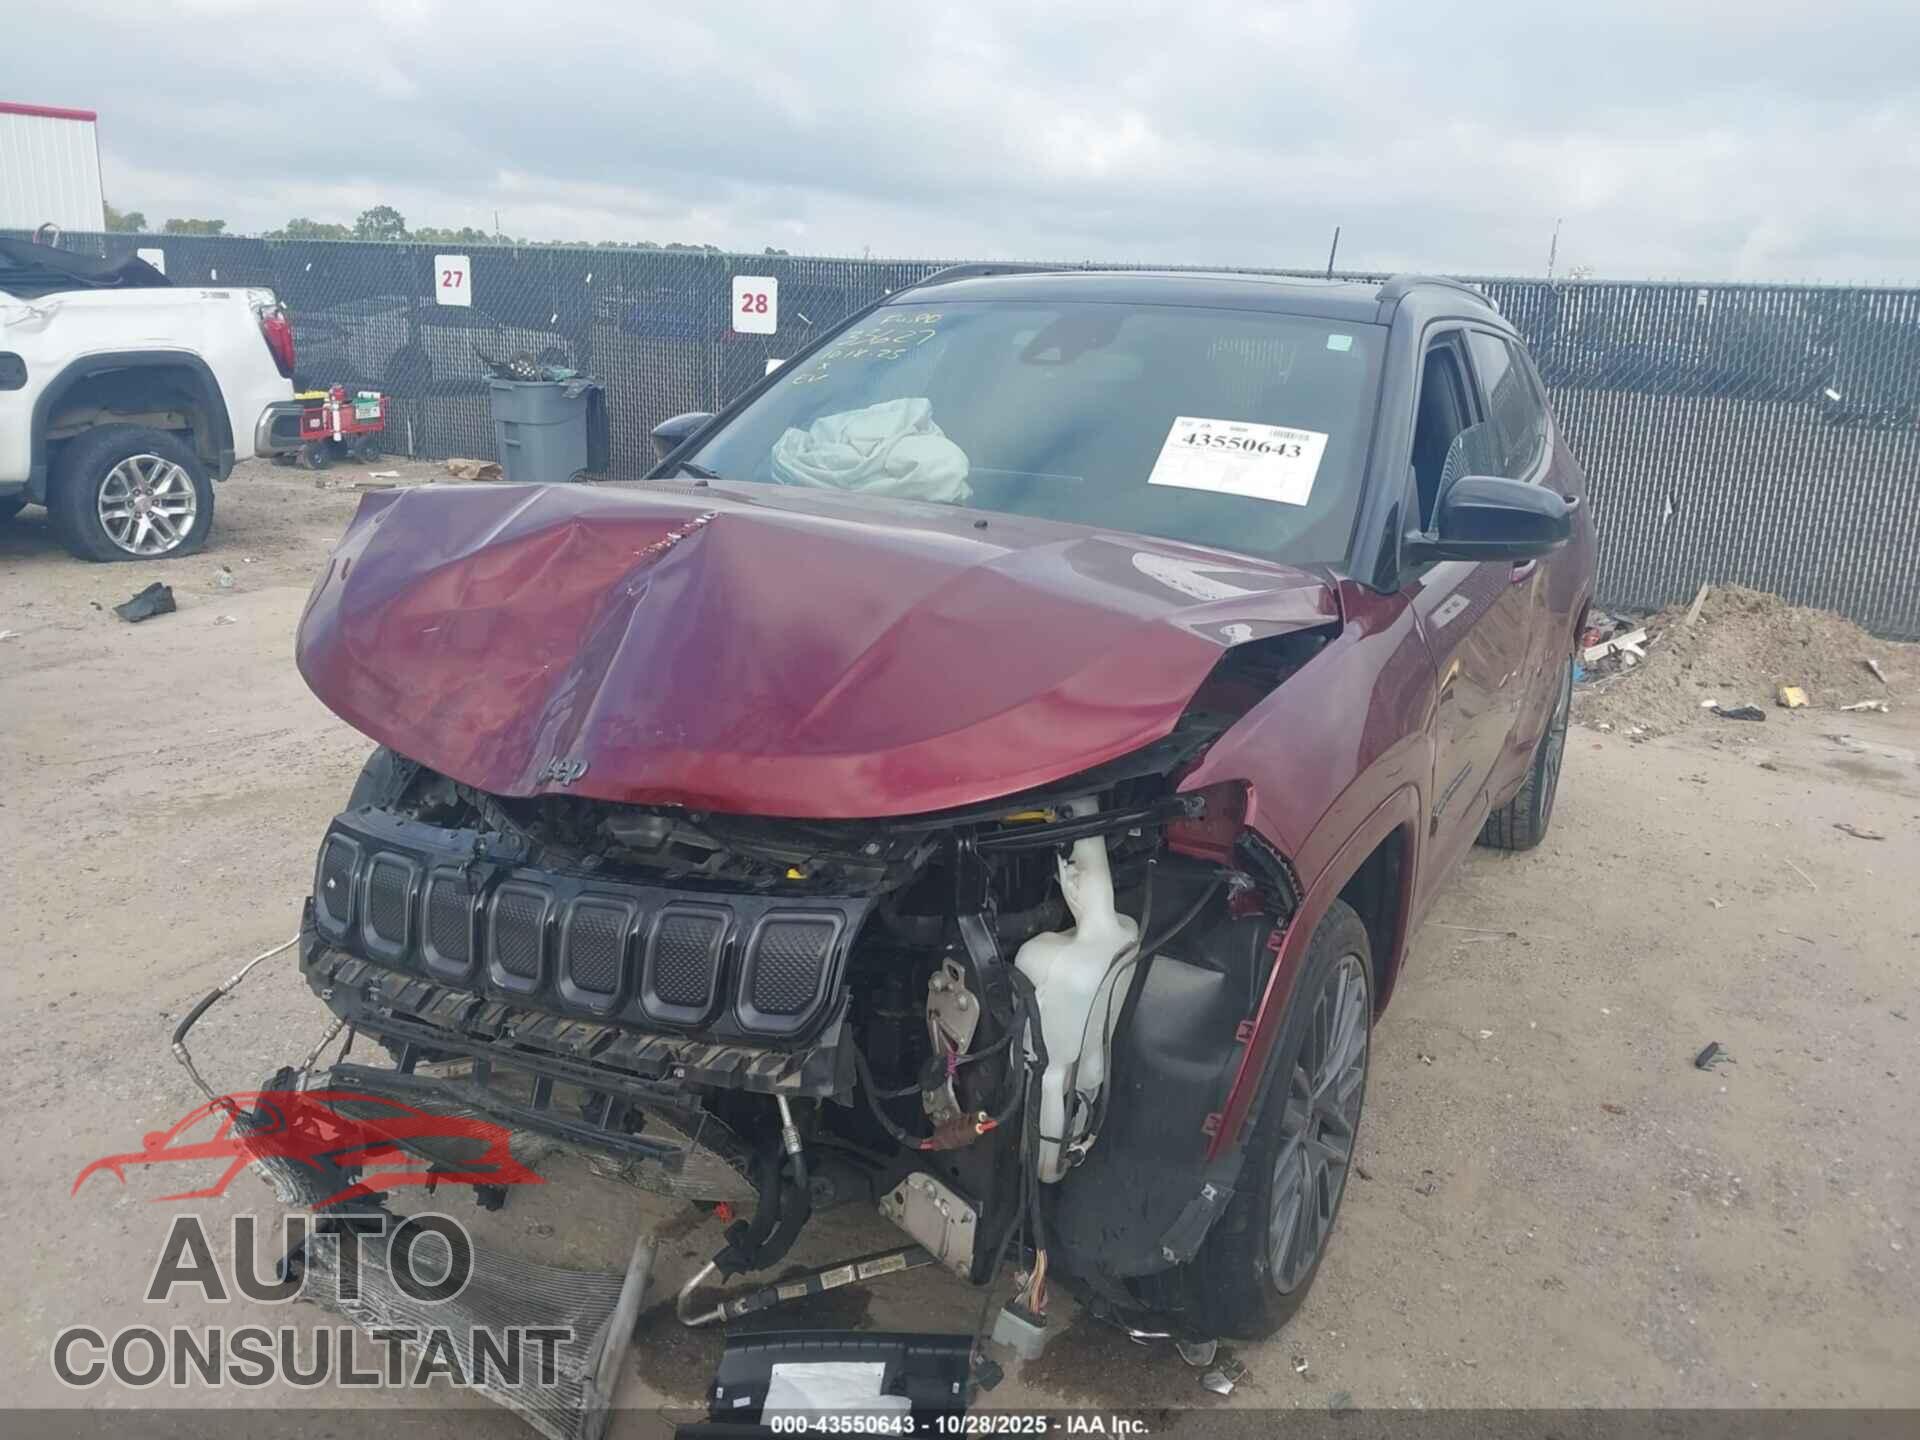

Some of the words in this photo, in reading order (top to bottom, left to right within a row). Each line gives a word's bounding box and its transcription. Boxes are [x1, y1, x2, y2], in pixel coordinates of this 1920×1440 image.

[442, 270, 463, 288] 27
[741, 293, 768, 314] 28
[1181, 432, 1302, 458] 43550643
